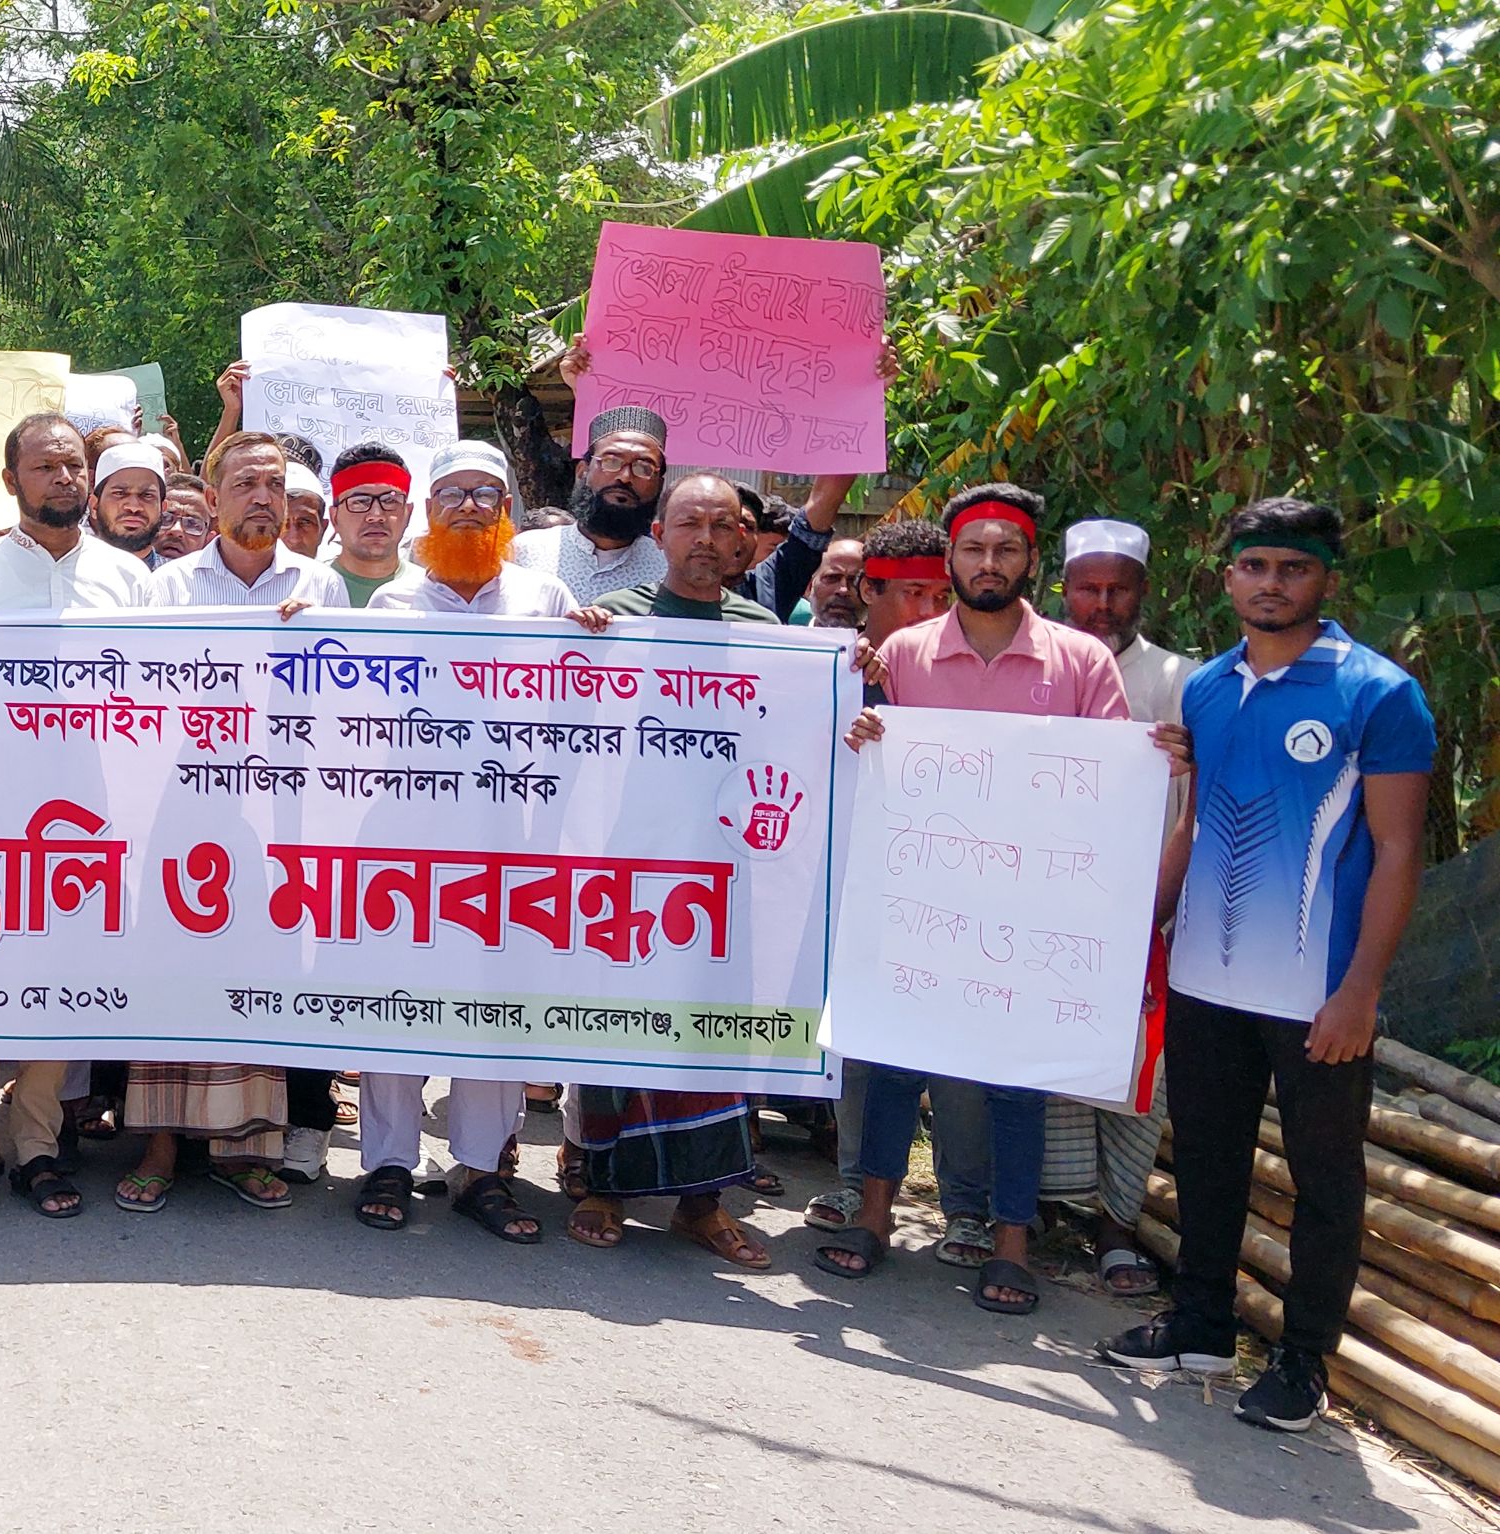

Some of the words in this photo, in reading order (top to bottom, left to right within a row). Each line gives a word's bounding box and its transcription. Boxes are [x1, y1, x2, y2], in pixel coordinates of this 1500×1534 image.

[609, 242, 714, 308] খেলা
[605, 305, 690, 365] বল
[699, 317, 836, 399] মাদক
[800, 415, 868, 455] চল
[140, 649, 244, 694] সংগঠন
[256, 637, 437, 697] "বাতিঘর"
[449, 650, 644, 702] আয়োজিত
[654, 665, 767, 719] মাদক,
[5, 691, 169, 746] অনলাইন
[179, 702, 257, 754] জুয়া
[267, 715, 317, 750] সহ
[337, 706, 475, 751] সামাজিক
[483, 720, 626, 757] অবক্ষয়ের
[636, 715, 741, 763] বিরুদ্ধে
[177, 755, 310, 797] সামাজিক
[317, 763, 465, 802] আন্দোলন
[472, 759, 561, 804] শীর্ষক
[900, 740, 995, 802] নেশা
[1028, 752, 1102, 802] নয়
[752, 816, 786, 840] না
[161, 840, 237, 938] ও
[266, 843, 737, 965] মানববন্ধন
[881, 893, 973, 951] মাদক
[979, 919, 1015, 963] ও
[20, 986, 51, 1010] মে
[58, 985, 128, 1012] ২০২৬
[292, 989, 445, 1026] তেতুলবাড়িয়া
[453, 999, 532, 1033] বাজার,
[544, 1006, 681, 1042] মোরেলগঞ্জ,
[692, 1011, 796, 1044] বাগেরহাট
